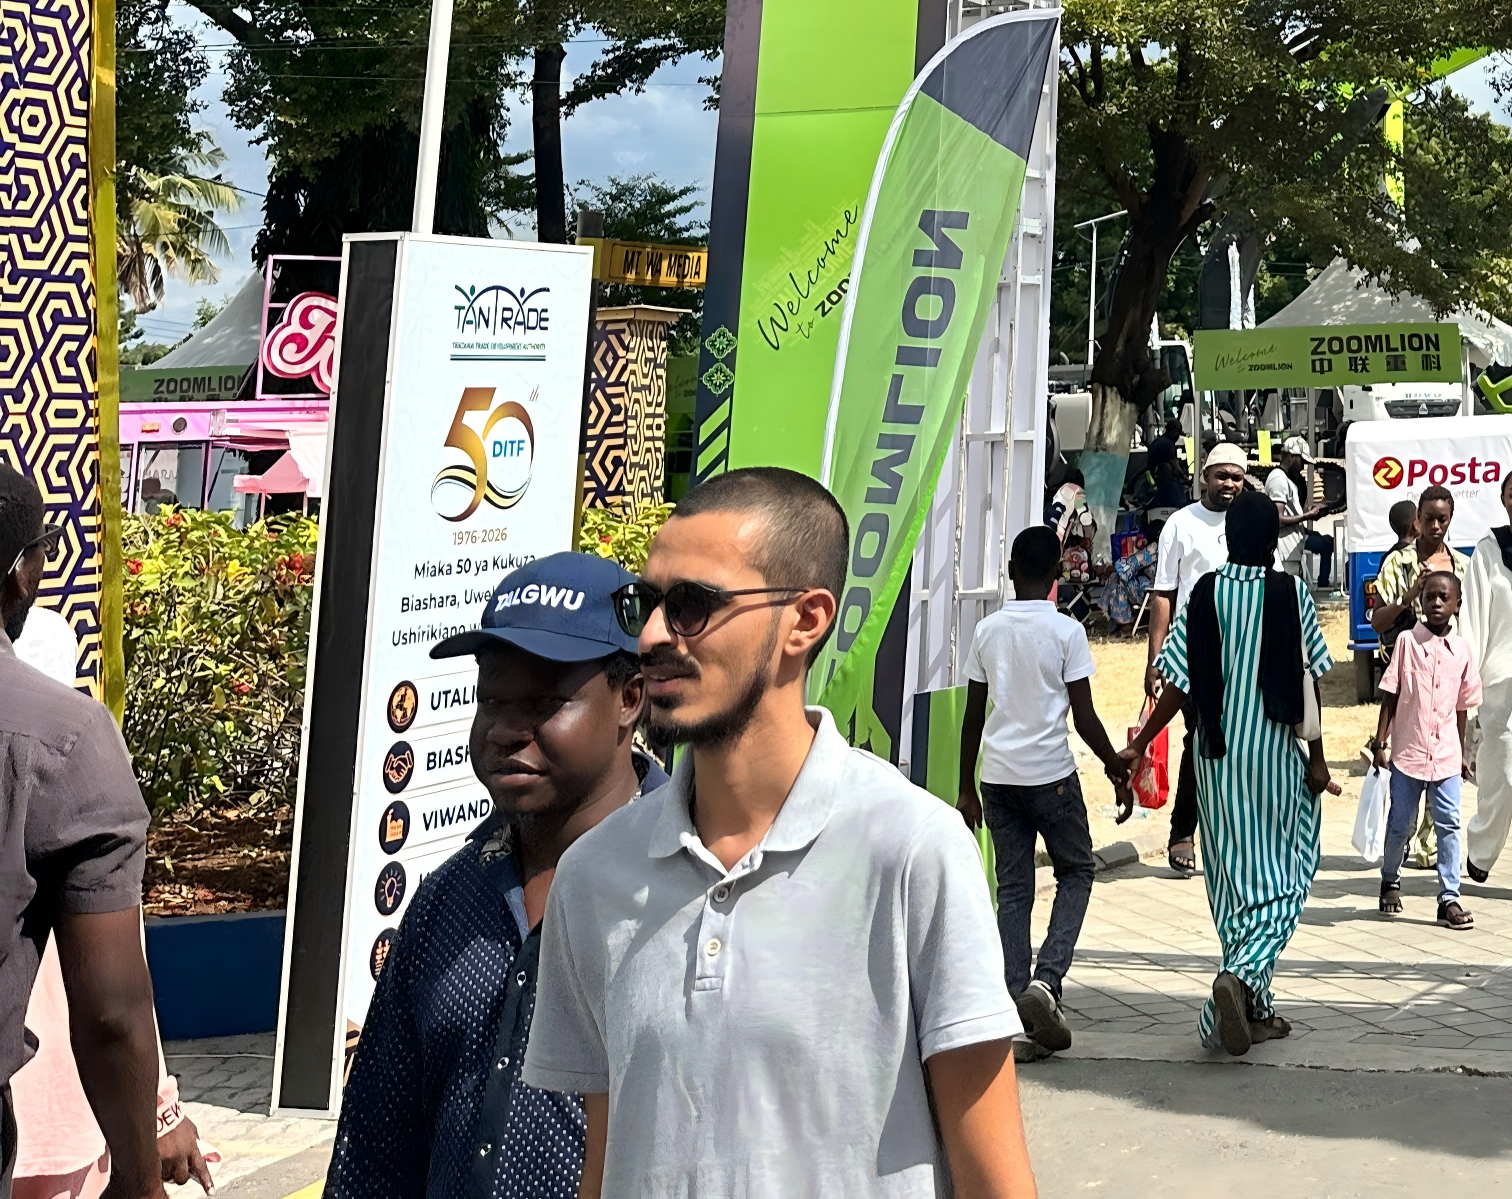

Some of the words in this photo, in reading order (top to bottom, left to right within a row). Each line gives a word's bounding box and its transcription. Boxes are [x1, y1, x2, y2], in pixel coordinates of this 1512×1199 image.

[645, 251, 663, 278] WA
[666, 253, 702, 280] MEDIA
[757, 204, 858, 351] Welcome
[814, 271, 851, 318] ZOO
[1309, 332, 1441, 356] ZOOMLION
[492, 439, 526, 458] DITF
[1406, 456, 1501, 488] Posta
[452, 527, 508, 546] 1976-2026
[413, 559, 453, 580] Miaka
[455, 558, 472, 575] 50
[474, 558, 489, 577] ya
[400, 590, 460, 613] Biashara,
[464, 585, 495, 605] Uwe
